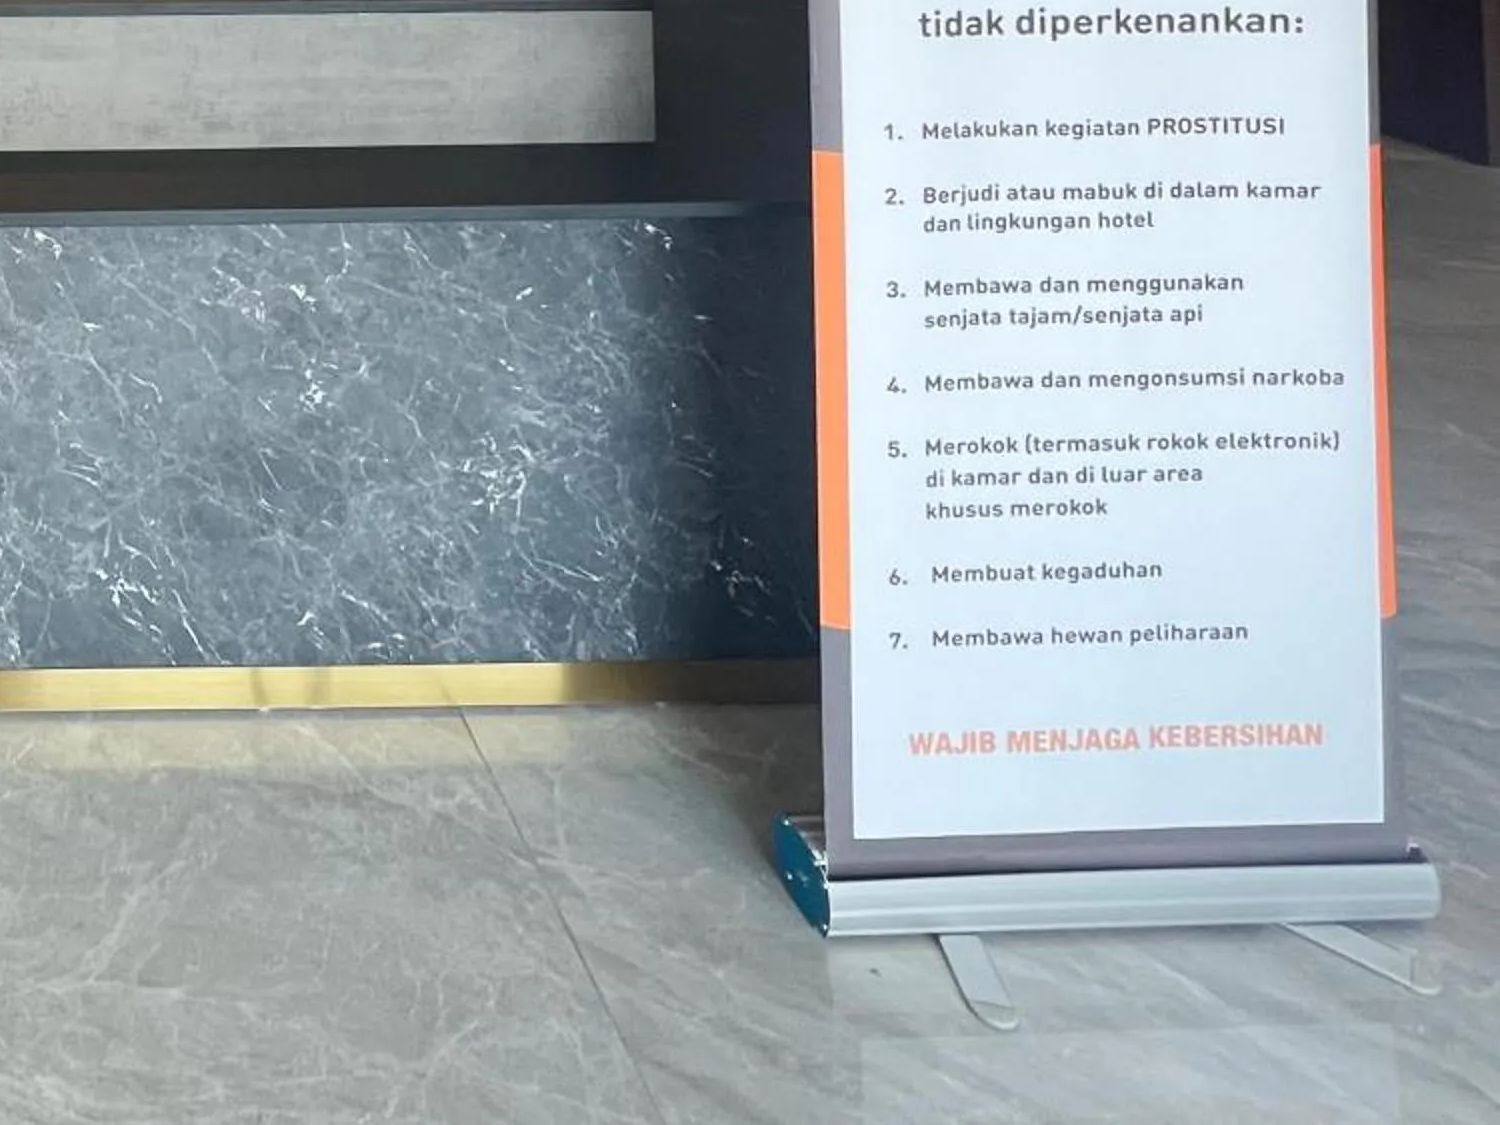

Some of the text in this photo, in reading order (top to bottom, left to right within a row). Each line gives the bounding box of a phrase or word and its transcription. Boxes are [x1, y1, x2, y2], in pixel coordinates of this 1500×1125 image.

[918, 6, 1303, 42] tidak diperkenankan:
[884, 116, 1285, 141] 1. Melakukan kegiatan PROSTITUSI
[884, 181, 1322, 207] 2. Berjudi atau mabuk di dalam kamar
[923, 210, 1155, 234] dan lingkungan hotel
[886, 273, 1244, 299] 3. Membawa dan menggunakan
[924, 303, 1203, 331] senjata tajam/senjata api
[886, 367, 1345, 394] 4. Membawa dan mengonsumsi narkoba
[887, 430, 1340, 459] 5. Merokok (termasuk rokok elektronik)
[925, 465, 1203, 488] di kamar dan di luar area
[925, 497, 1108, 520] khusus merokok
[888, 560, 1163, 586] 6. Membuat kegaduhan
[888, 623, 1249, 650] 7. Membawa hewan peliharaan
[908, 722, 1324, 756] WAJIB MENJAGA KEBERSIHAN
